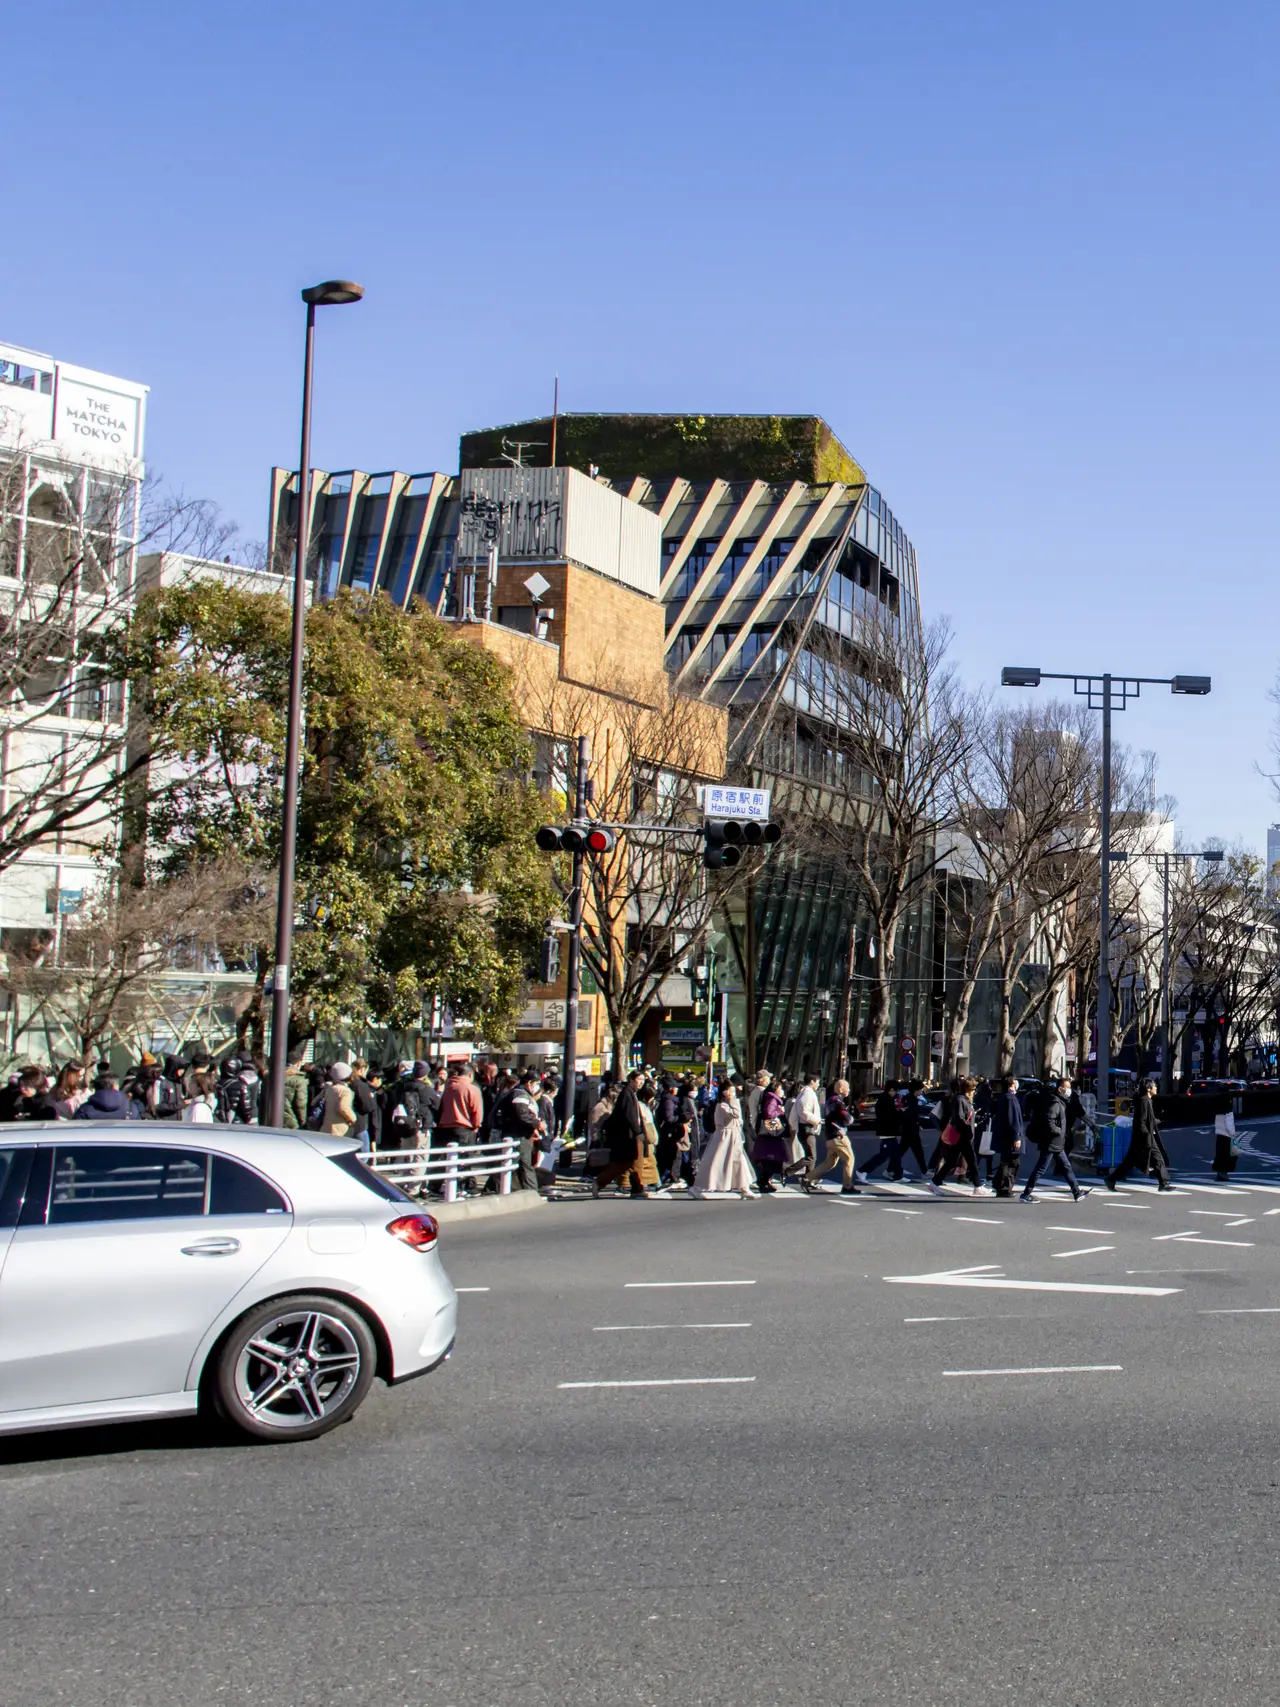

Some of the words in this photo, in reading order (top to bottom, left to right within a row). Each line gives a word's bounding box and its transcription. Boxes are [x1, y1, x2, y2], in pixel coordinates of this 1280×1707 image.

[86, 397, 111, 413] THE
[66, 406, 127, 431] MATCHA
[72, 422, 121, 443] TOKYO
[711, 789, 764, 806] 原宿駅前
[711, 802, 746, 814] Harajuku
[748, 805, 762, 816] Sta.
[661, 1029, 704, 1039] FamilyMart
